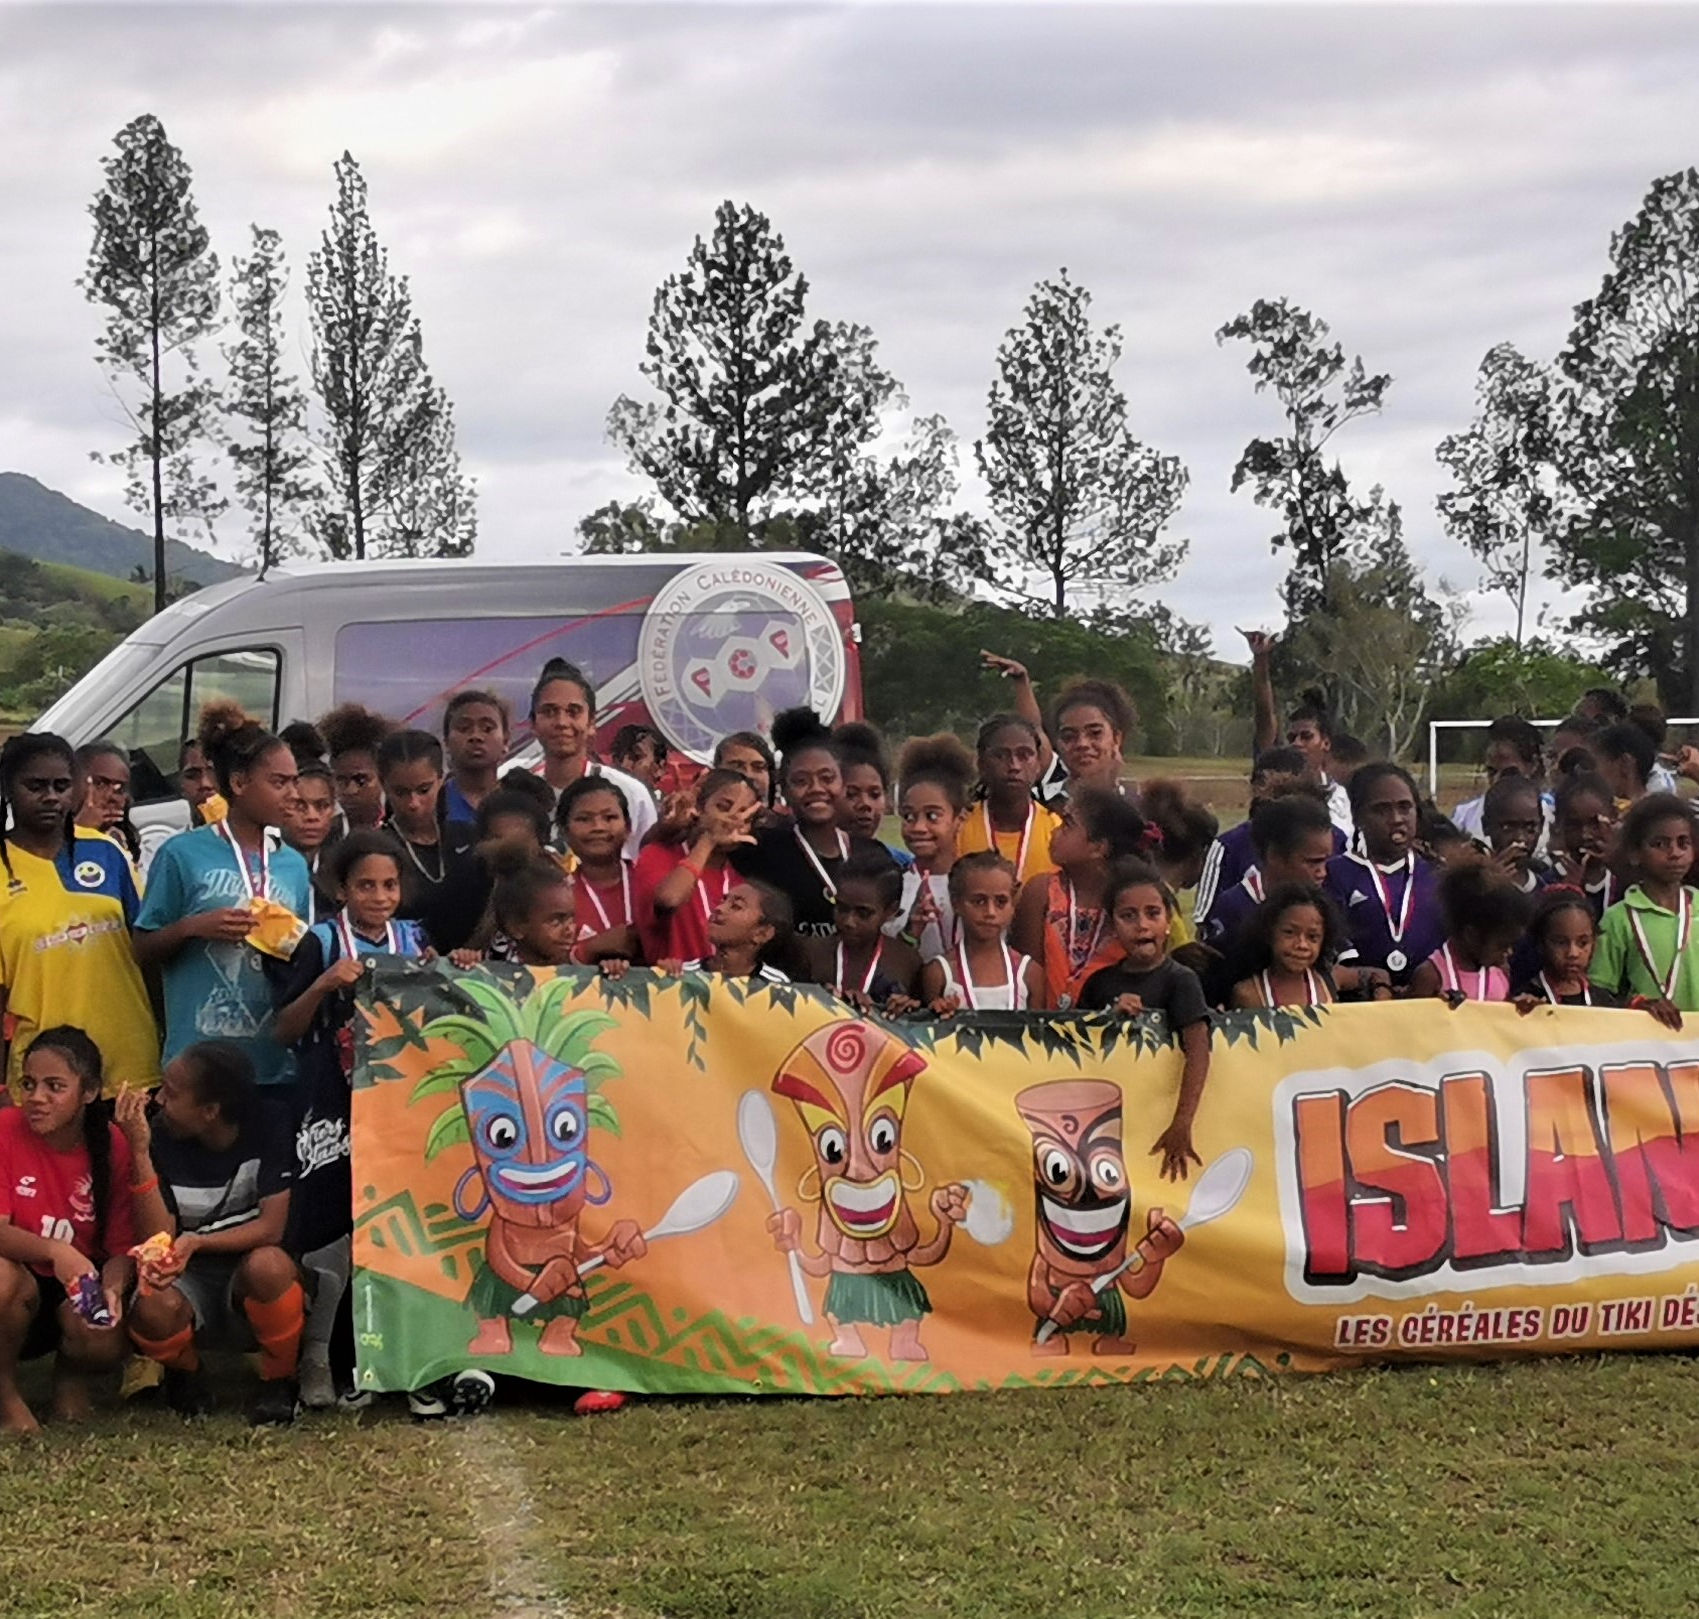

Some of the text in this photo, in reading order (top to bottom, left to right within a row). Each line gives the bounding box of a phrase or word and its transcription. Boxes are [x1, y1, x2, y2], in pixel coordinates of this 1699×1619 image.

[696, 568, 818, 625] CALÉDONIENNE
[41, 1215, 74, 1245] 10
[1338, 1318, 1389, 1344] LES
[1401, 1303, 1541, 1344] CÉRÉALES
[1552, 1306, 1588, 1334] DU
[1602, 1300, 1651, 1332] TIKI
